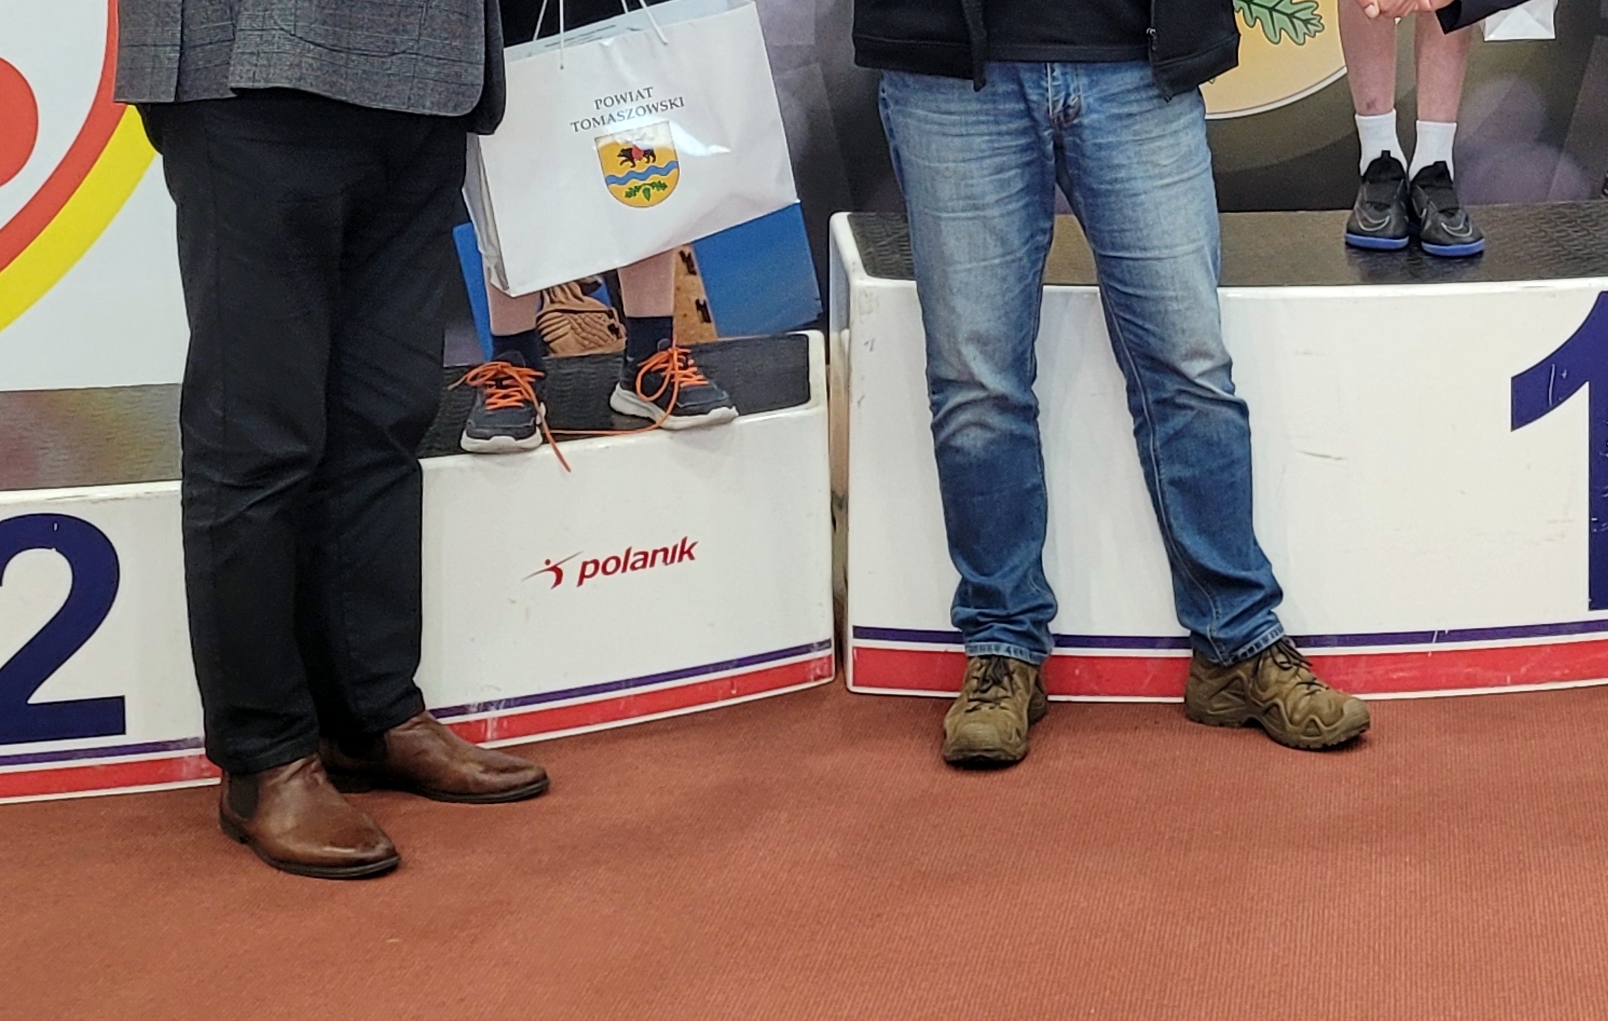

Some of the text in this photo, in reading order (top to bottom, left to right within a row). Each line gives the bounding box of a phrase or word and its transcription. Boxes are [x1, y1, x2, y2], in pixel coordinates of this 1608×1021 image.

[570, 96, 685, 133] TOMASZOWSKI
[594, 86, 654, 110] POWIAT
[576, 535, 699, 588] polanik
[0, 512, 126, 745] 2
